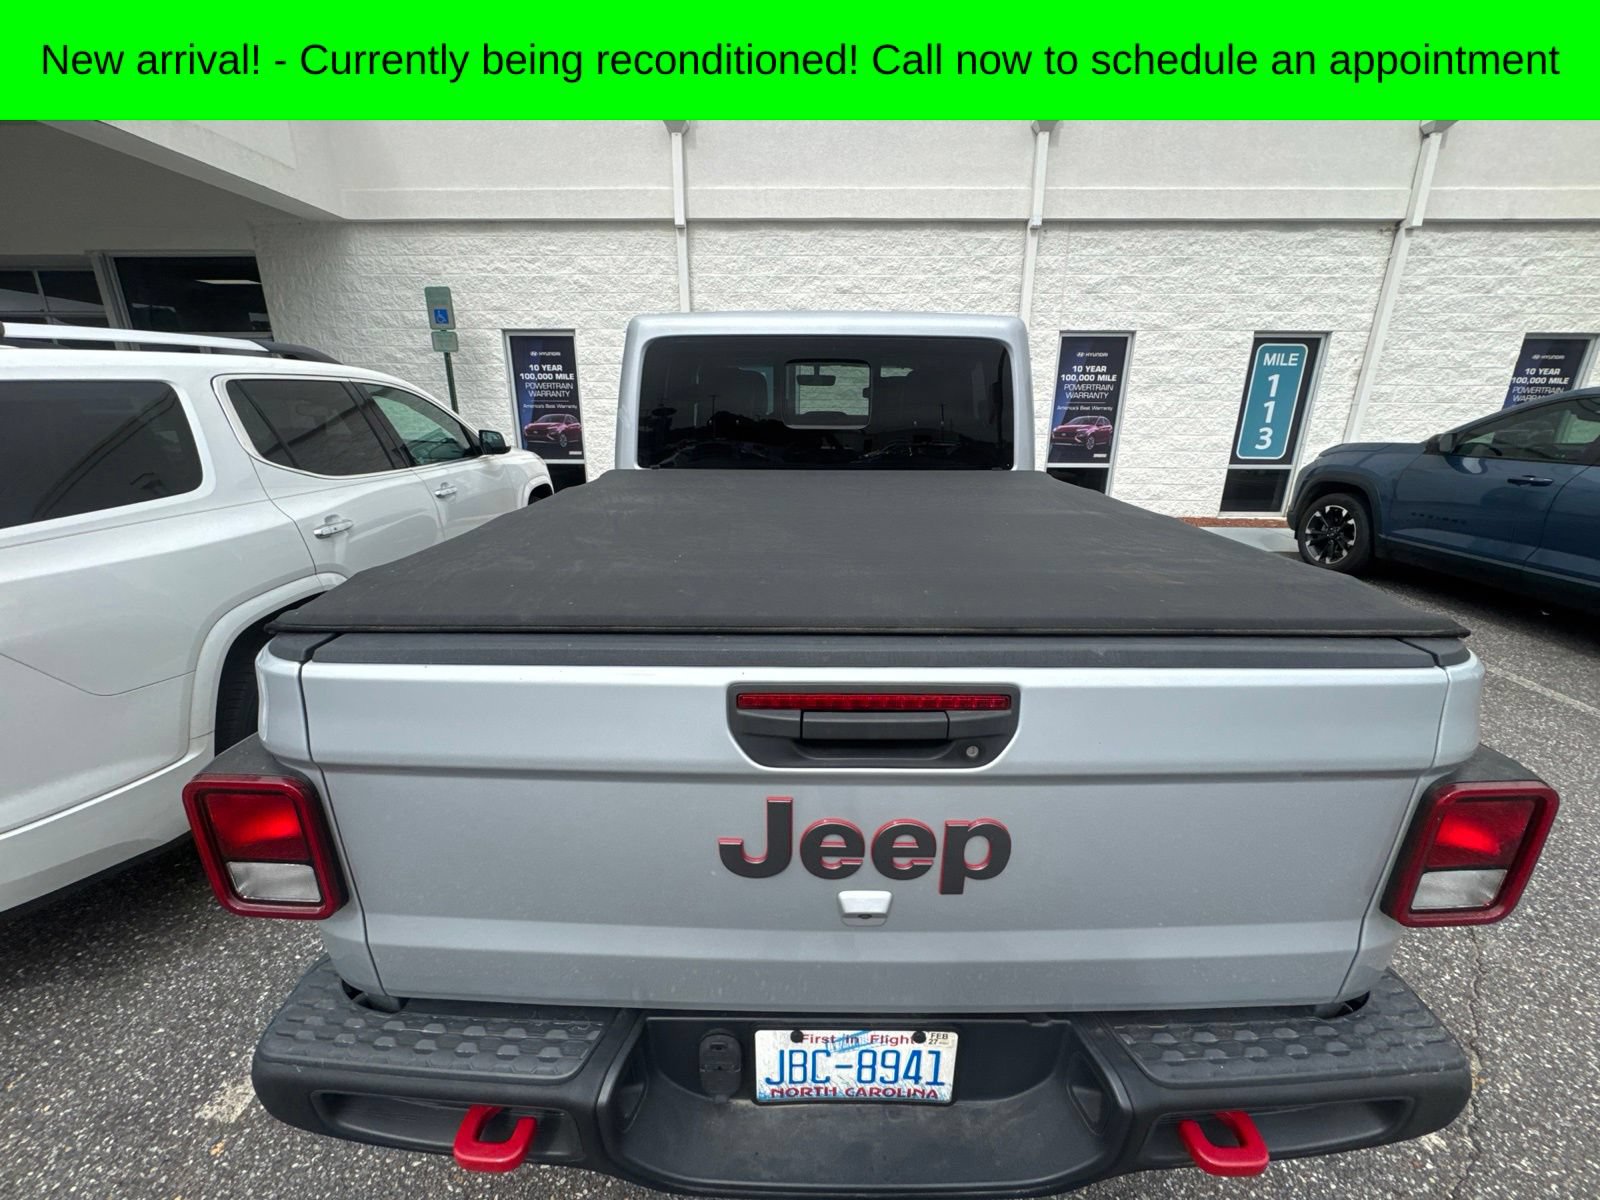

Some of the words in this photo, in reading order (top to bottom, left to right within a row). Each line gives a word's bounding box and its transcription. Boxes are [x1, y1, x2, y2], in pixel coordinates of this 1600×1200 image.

[1263, 353, 1299, 366] MILE
[1061, 374, 1095, 382] 100,000
[1063, 383, 1114, 391] POWERTRAIN
[717, 796, 1012, 895] Jeep
[802, 1034, 836, 1044] First
[930, 1032, 949, 1040] FEB
[764, 1050, 946, 1086] JBC-8941
[771, 1087, 837, 1098] NORTH
[845, 1087, 939, 1099] CAROLINA
